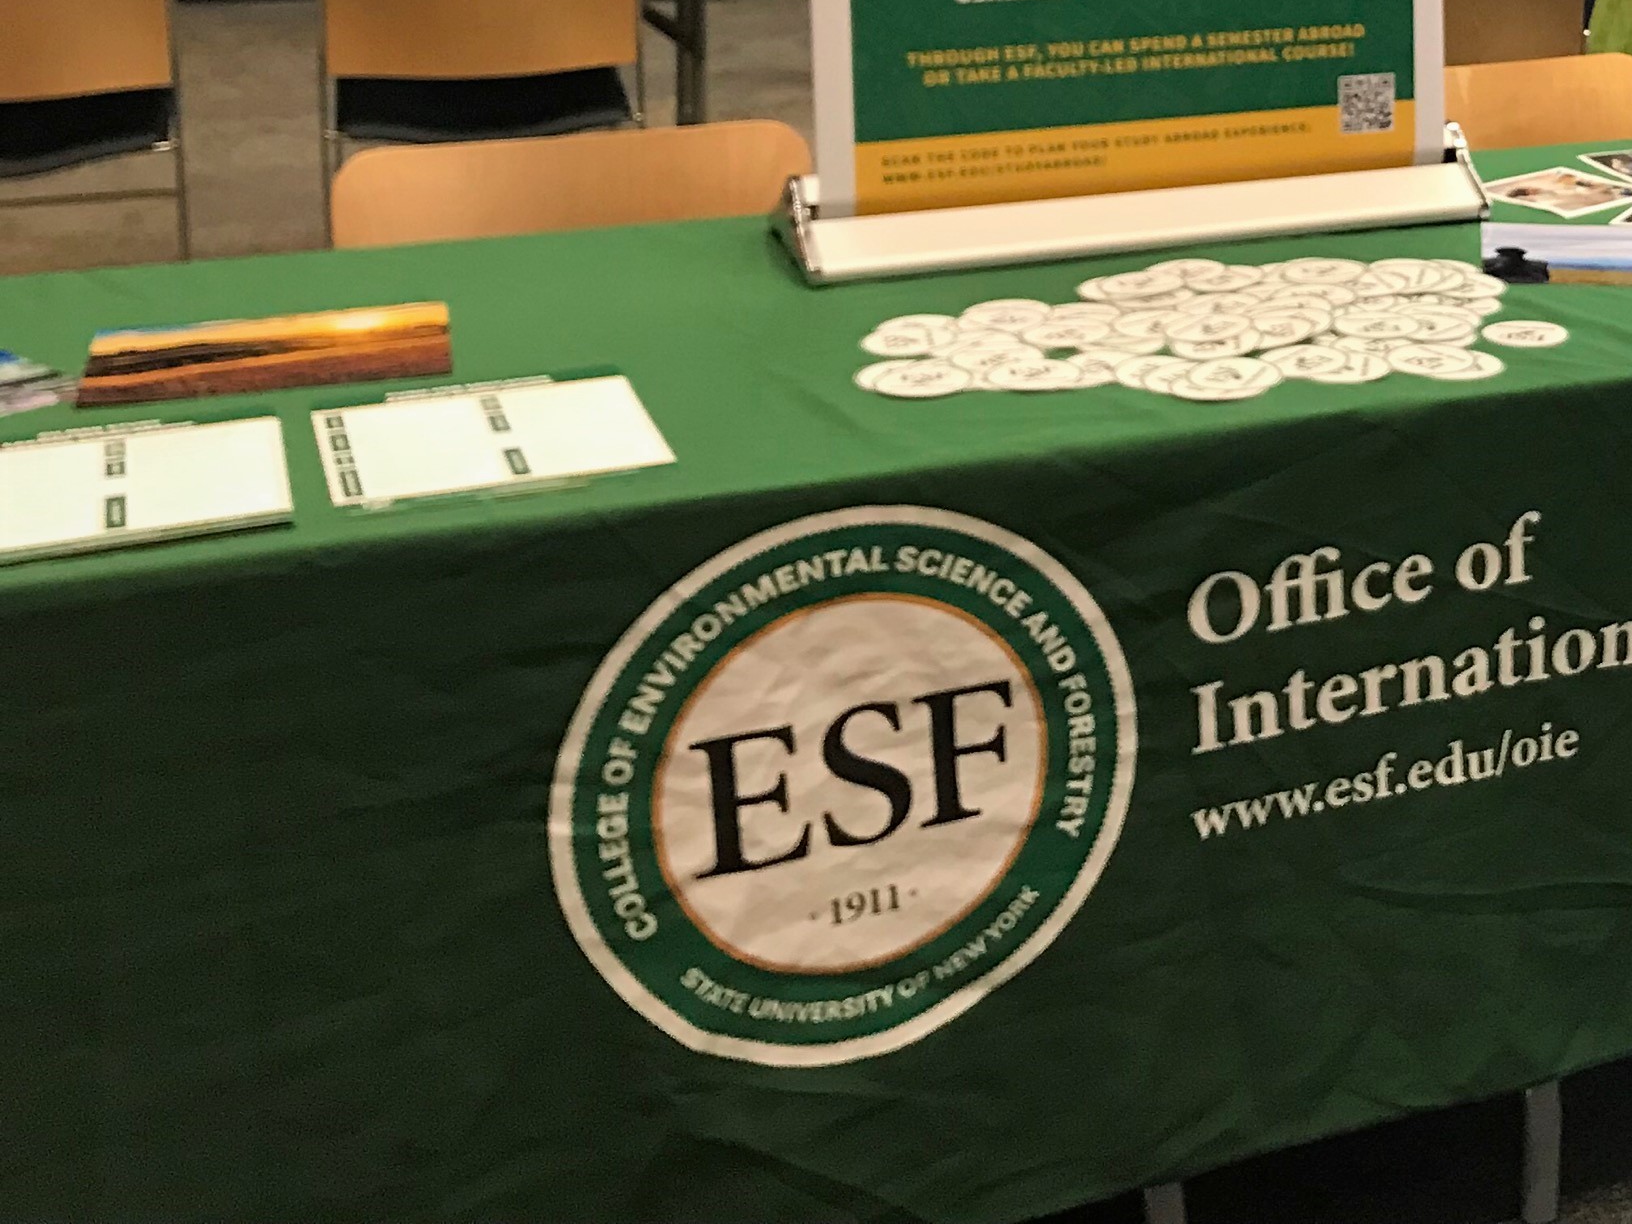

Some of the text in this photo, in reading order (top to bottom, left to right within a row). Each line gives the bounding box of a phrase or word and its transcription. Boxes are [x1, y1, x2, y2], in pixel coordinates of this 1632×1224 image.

[907, 48, 999, 67] THROUGH
[1047, 41, 1084, 58] YOU
[1087, 39, 1124, 56] CAN
[1129, 34, 1187, 52] SPEND
[1191, 33, 1203, 48] A
[1207, 27, 1293, 47] SEMESTER
[1298, 23, 1365, 41] ABROAD
[923, 70, 949, 87] OR
[955, 65, 1000, 84] TAKE
[1006, 64, 1018, 80] A
[1142, 48, 1277, 71] INTERNATIONAL
[1187, 510, 1542, 644] Office of
[596, 545, 1099, 941] COLLEGE OF ENVIRONMENTAL SCIENCE AND FORESTRY
[689, 680, 1014, 880] ESF
[1190, 721, 1580, 841] www.esf.edu/oie
[680, 883, 1041, 1024] STATE UNIVERSITY OF NEW YORK
